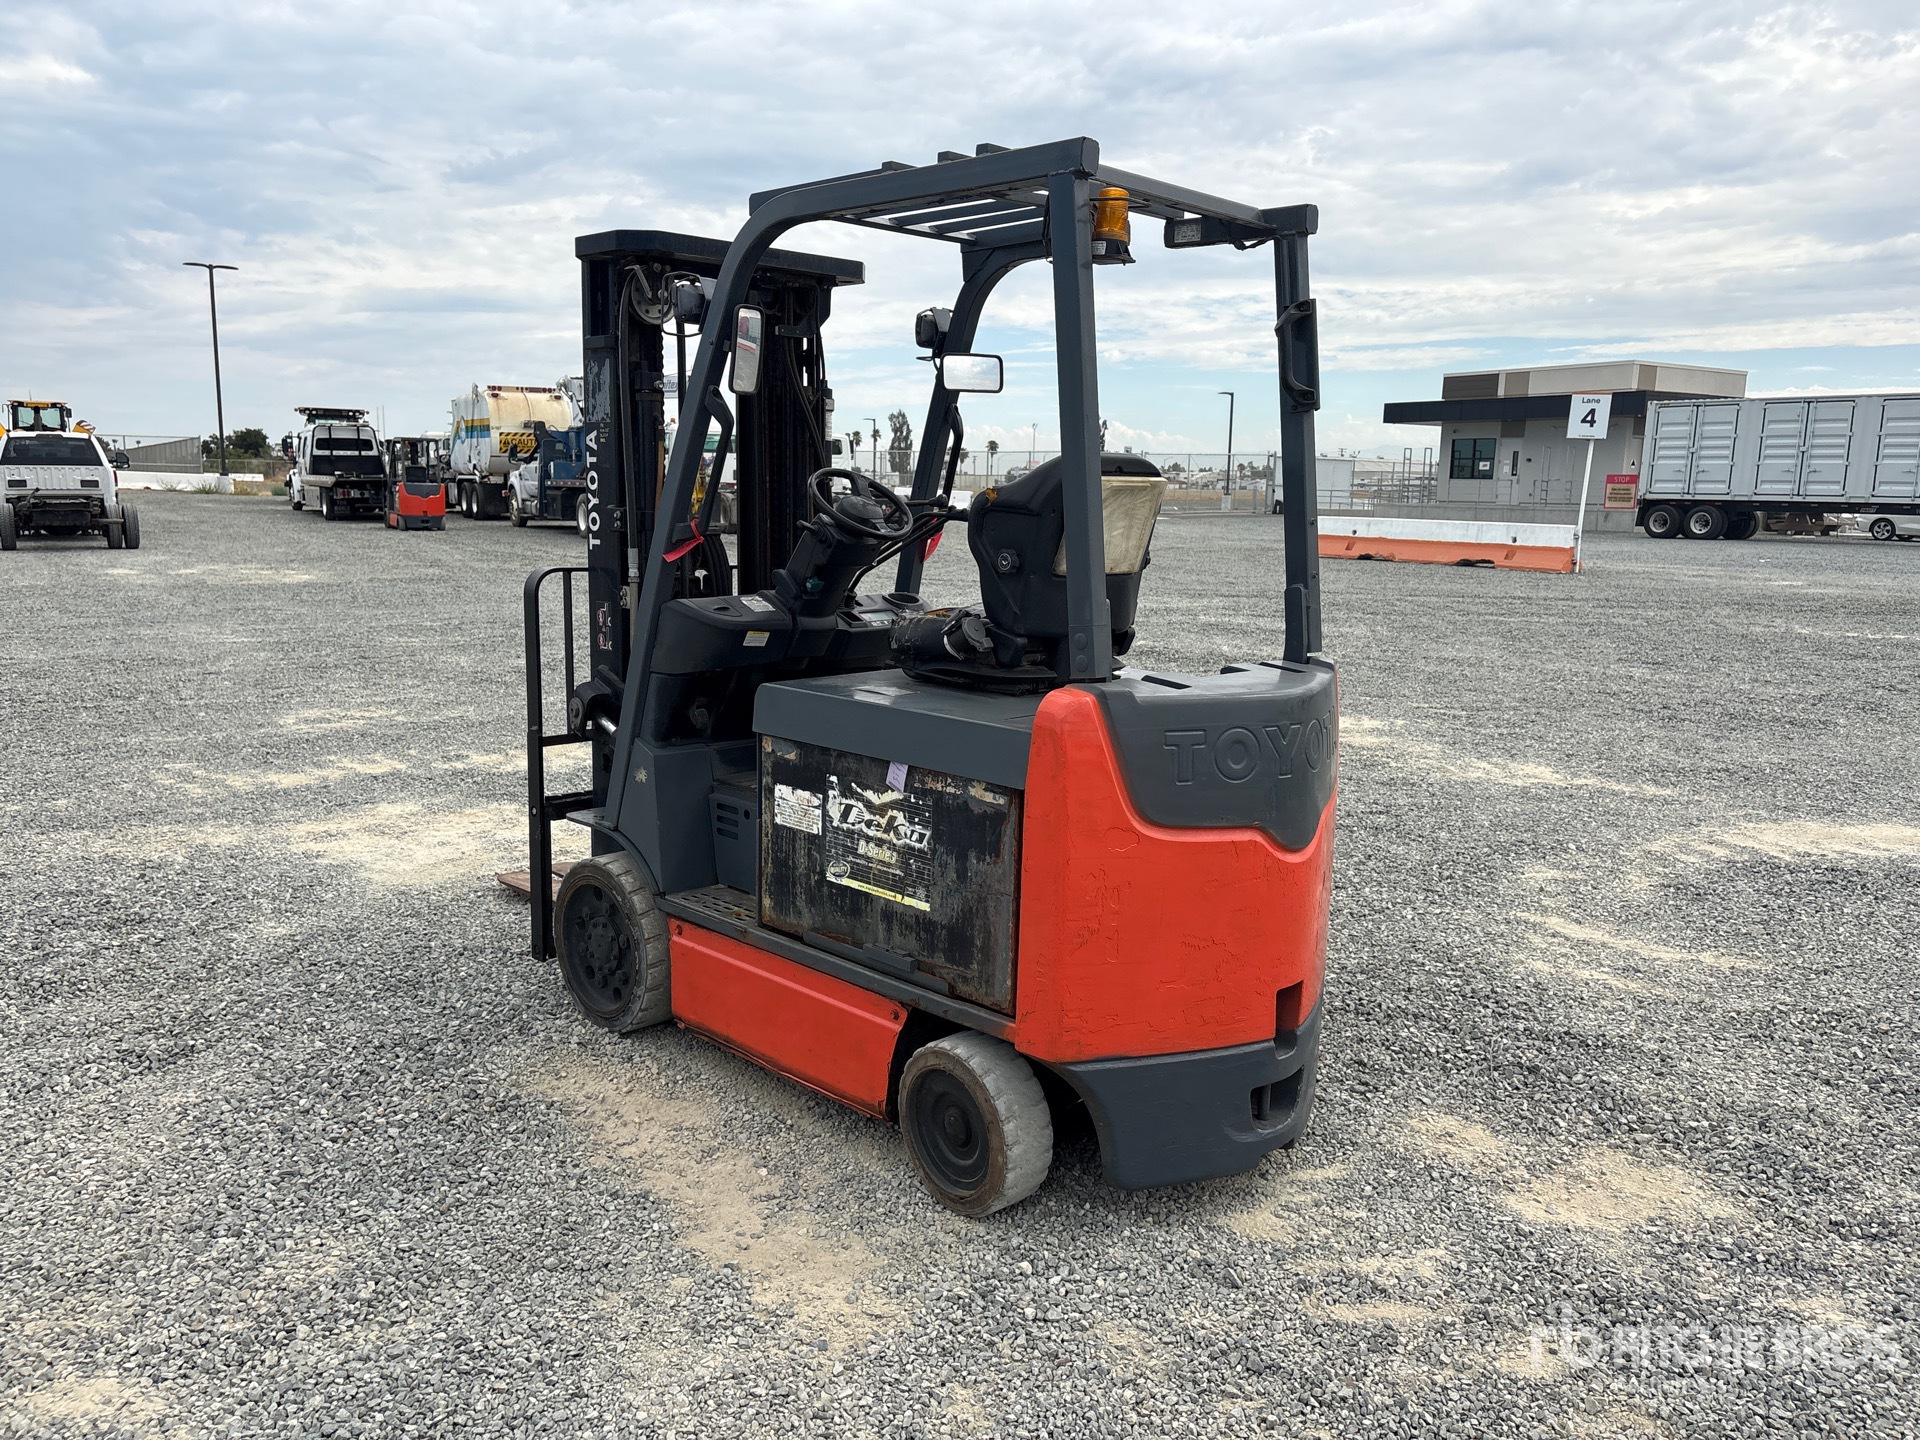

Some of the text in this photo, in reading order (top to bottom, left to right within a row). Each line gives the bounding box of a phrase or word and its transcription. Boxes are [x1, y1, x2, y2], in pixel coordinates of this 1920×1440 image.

[1580, 407, 1597, 428] 4
[586, 429, 601, 550] TOYOTA
[858, 840, 897, 863] D-Series
